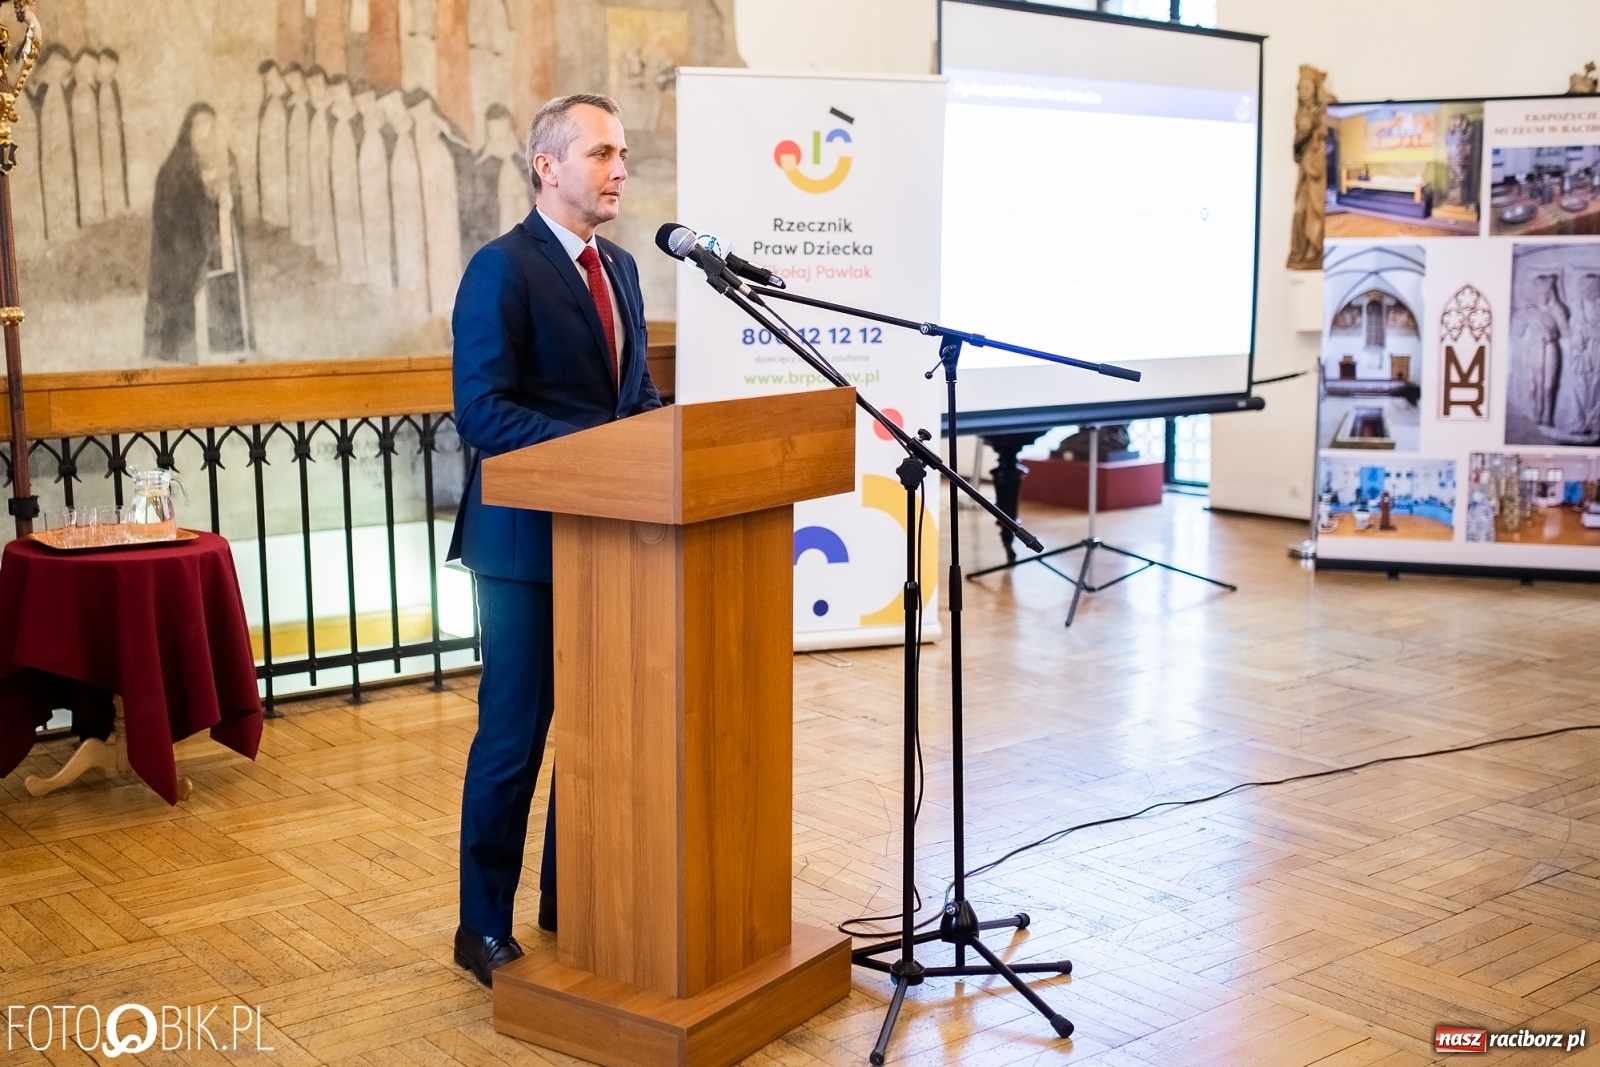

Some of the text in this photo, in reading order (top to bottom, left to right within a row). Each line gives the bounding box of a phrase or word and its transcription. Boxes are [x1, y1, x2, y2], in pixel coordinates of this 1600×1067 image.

[773, 217, 853, 232] Rzecznik
[753, 240, 873, 255] Praw Dziecka
[761, 264, 811, 282] kołaj
[816, 264, 872, 279] Pawlak
[797, 328, 821, 345] 12
[828, 328, 852, 344] 12
[860, 327, 883, 344] 12
[831, 354, 870, 363] zaufania
[744, 370, 880, 388] www.brpov.pl
